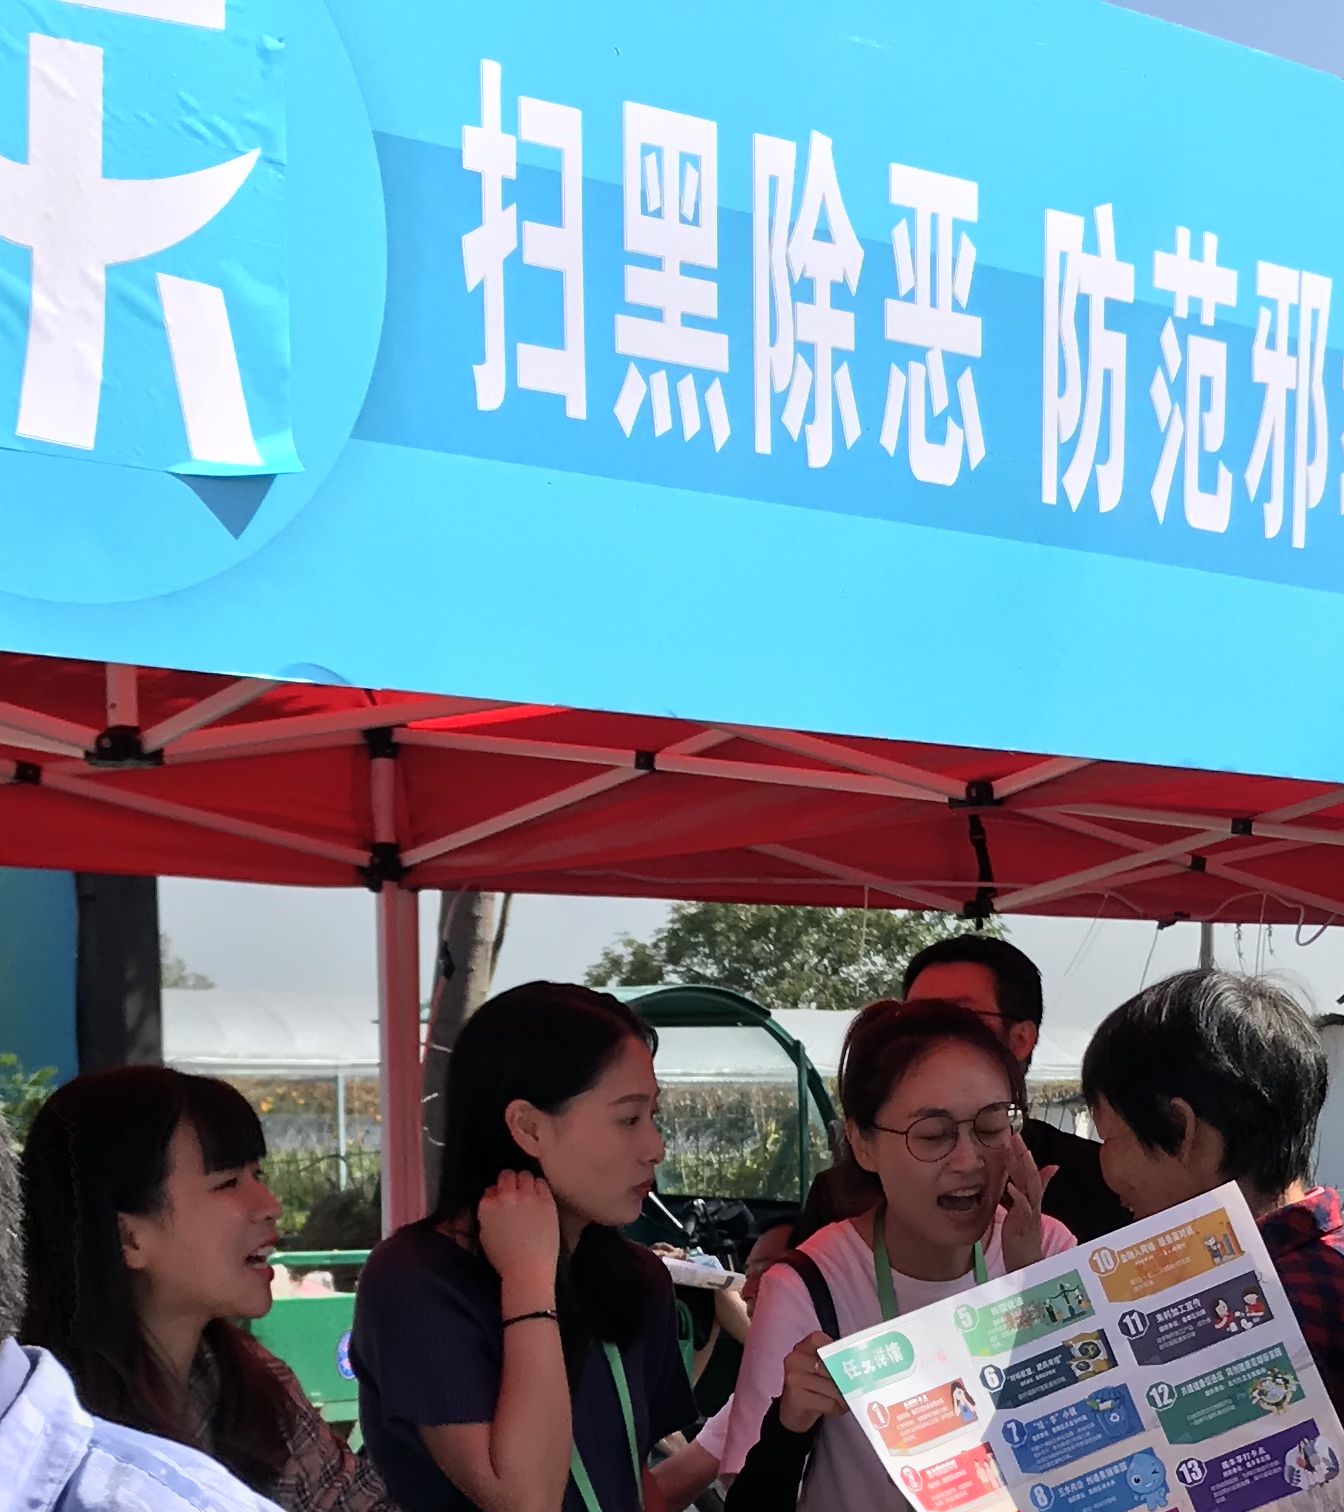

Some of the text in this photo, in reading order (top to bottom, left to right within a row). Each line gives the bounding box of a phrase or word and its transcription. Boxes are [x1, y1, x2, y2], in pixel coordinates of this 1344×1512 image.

[462, 59, 985, 486] 扫黑除恶
[1091, 1248, 1115, 1272] 10
[956, 1306, 974, 1329] 5
[1121, 1311, 1144, 1335] 11
[982, 1366, 1000, 1388] 6
[1148, 1383, 1172, 1407] 12
[1006, 1421, 1020, 1442] 7
[1177, 1458, 1203, 1484] 13
[1033, 1486, 1048, 1507] 8
